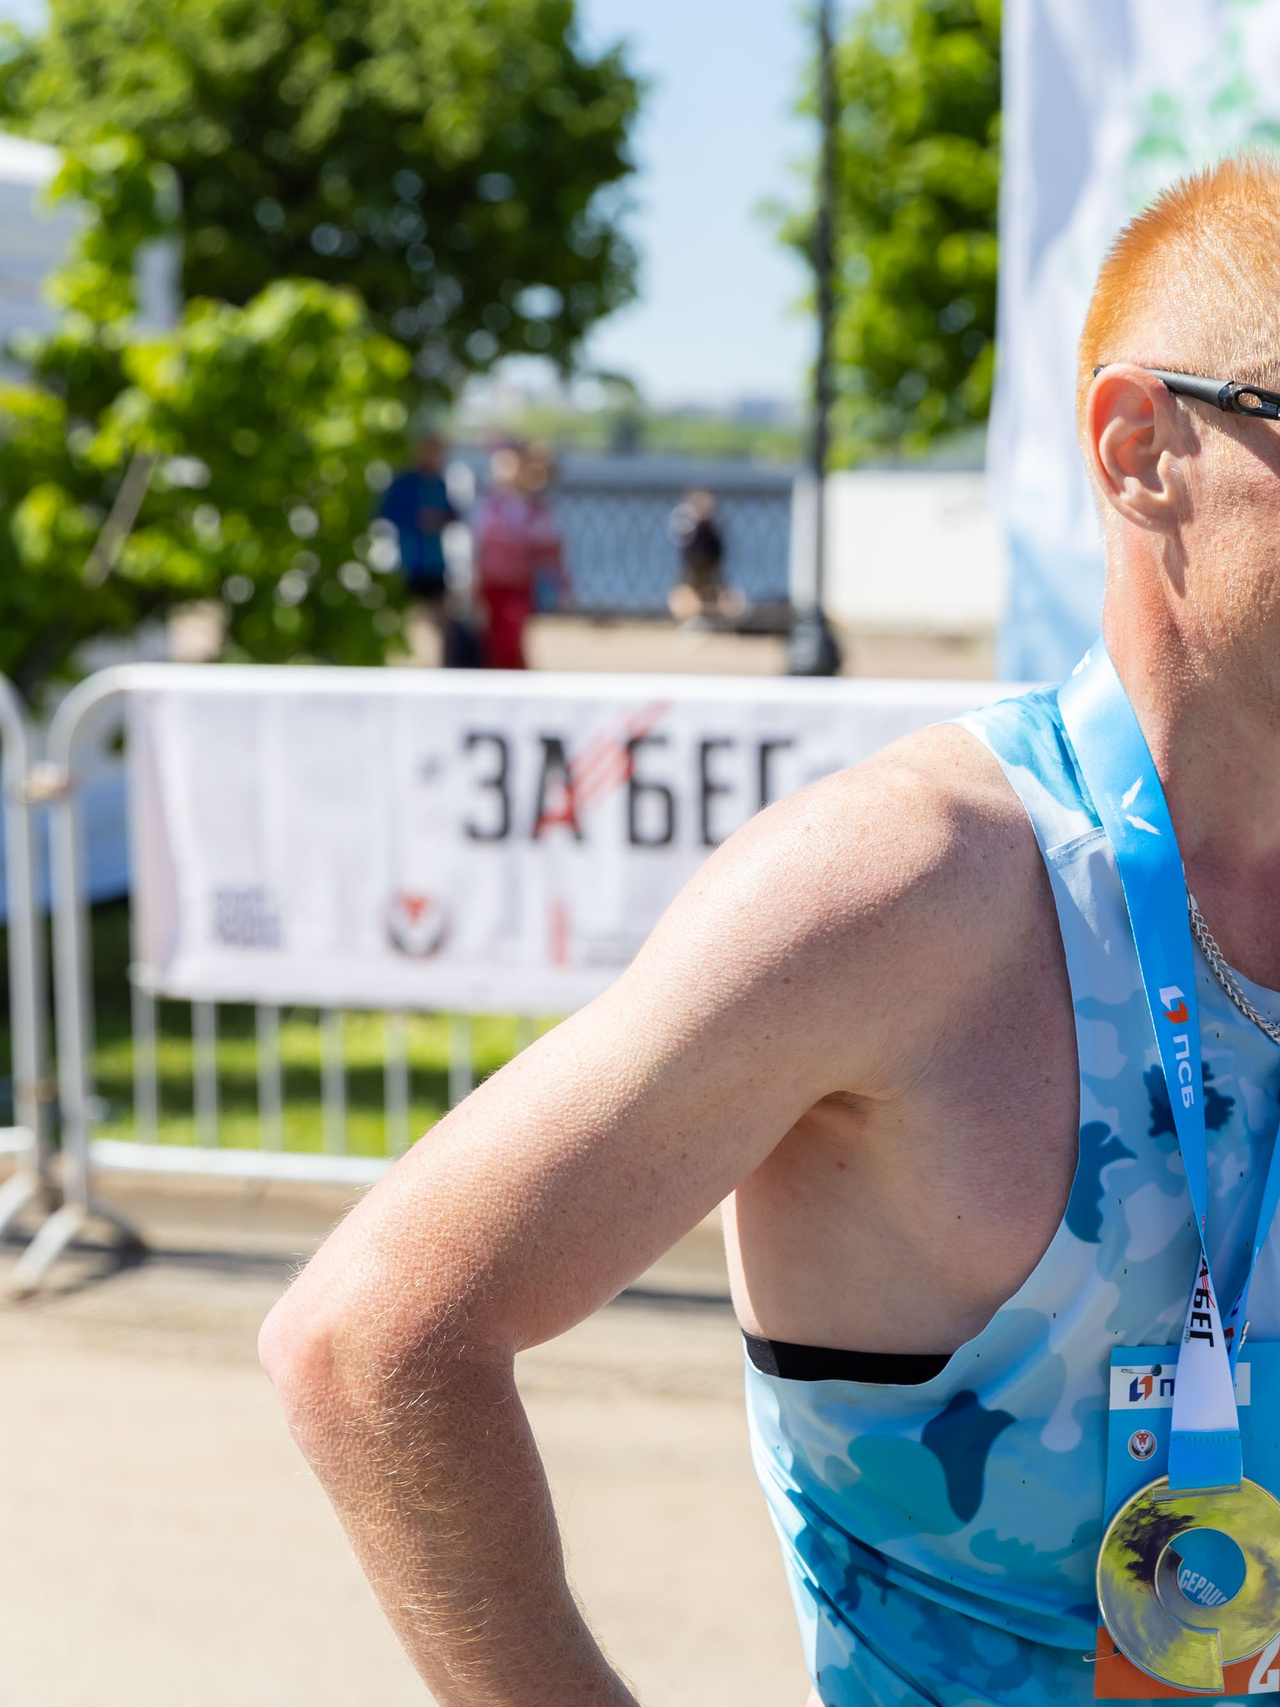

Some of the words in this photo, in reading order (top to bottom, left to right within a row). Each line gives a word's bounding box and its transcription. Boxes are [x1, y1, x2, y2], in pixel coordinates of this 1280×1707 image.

[463, 731, 583, 842] ЗА
[1172, 1034, 1195, 1109] ПСБ
[1190, 1288, 1214, 1347] БЕГ
